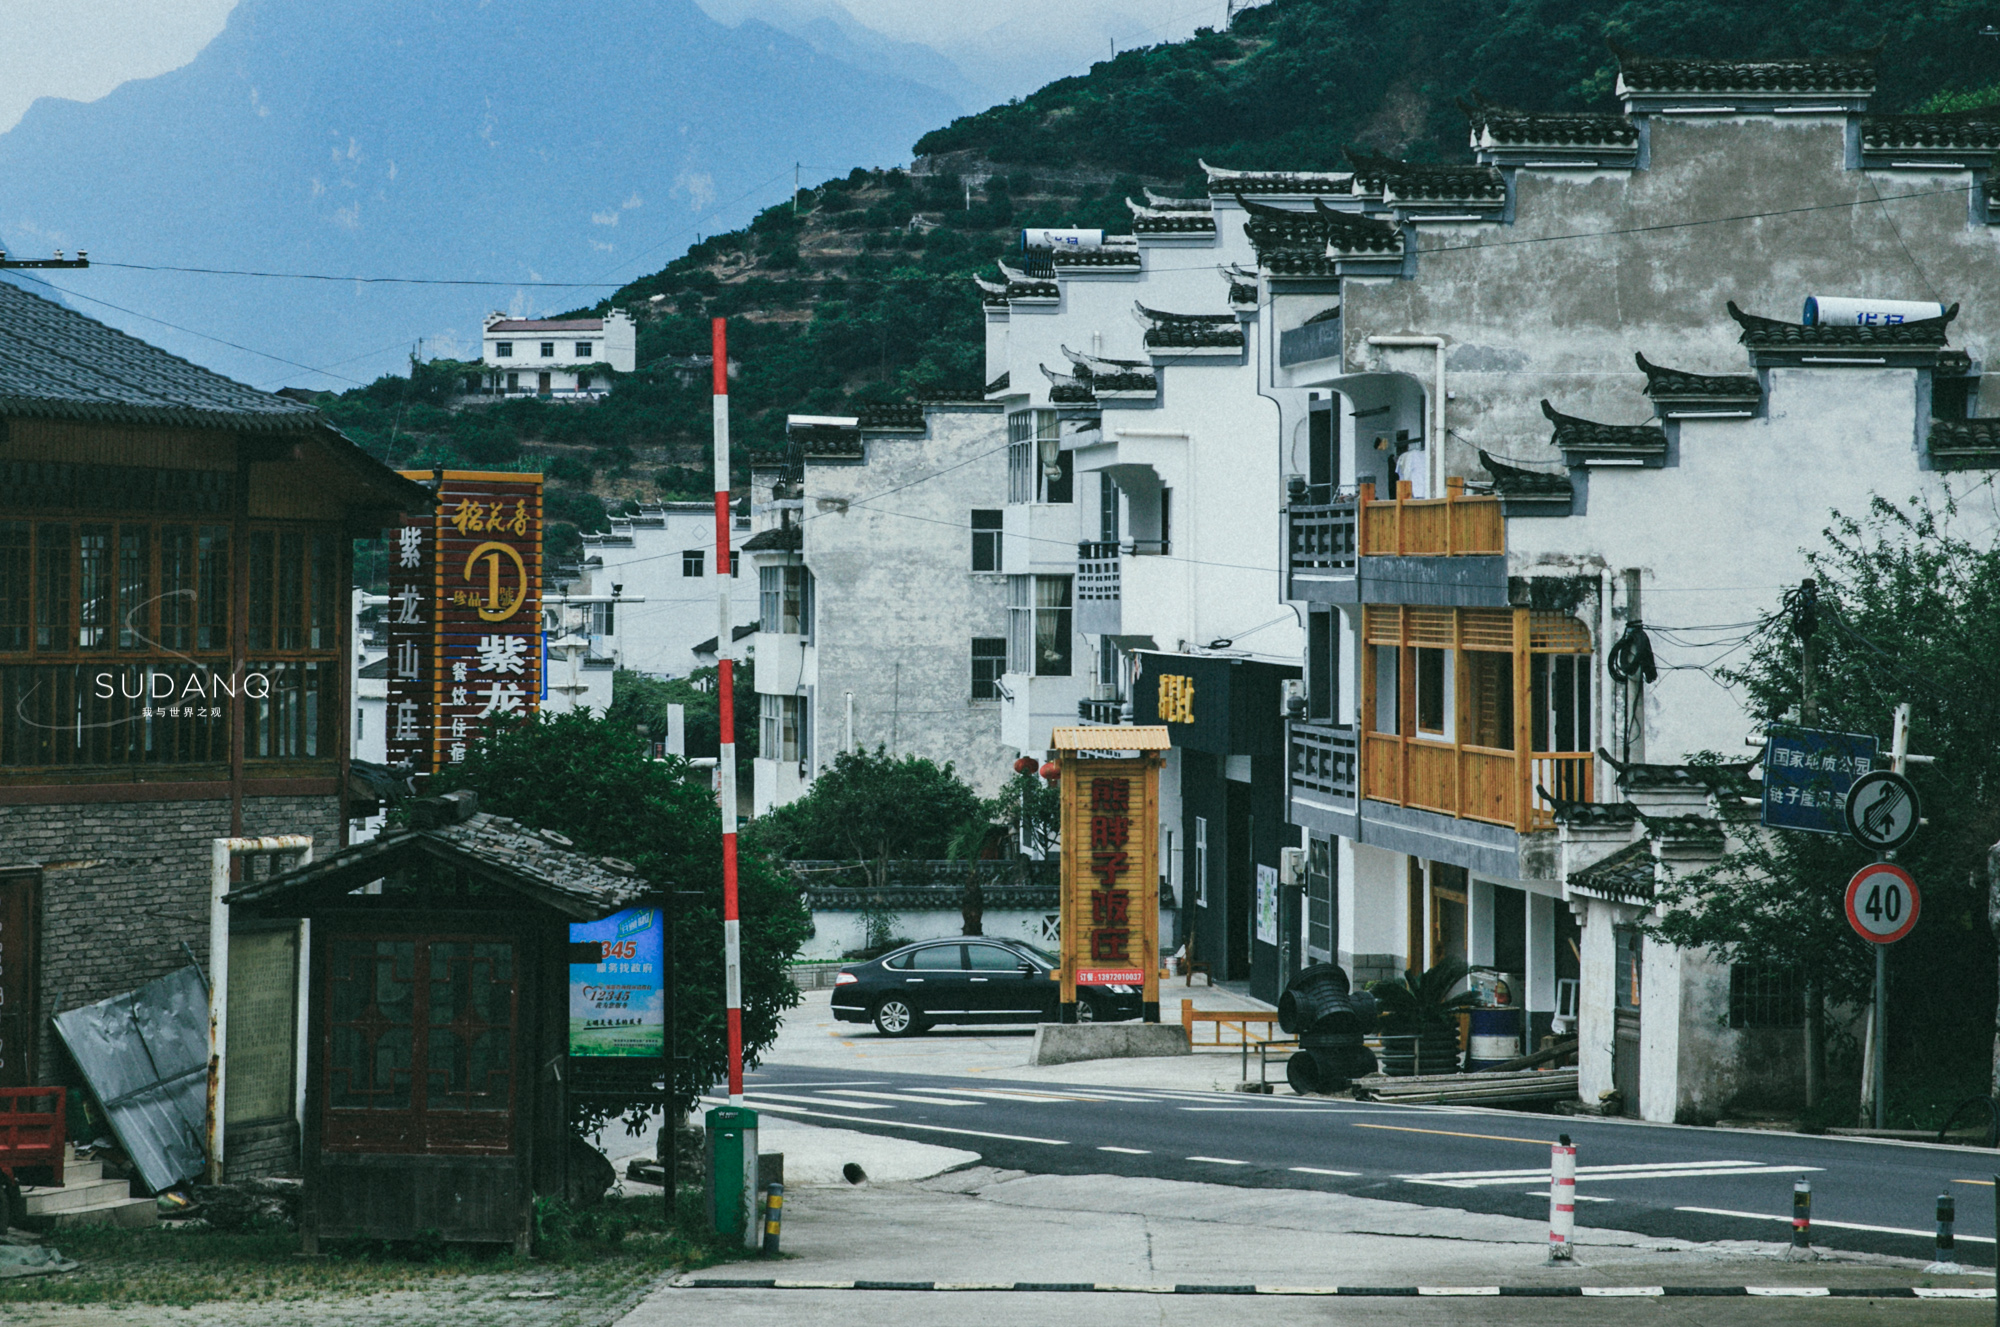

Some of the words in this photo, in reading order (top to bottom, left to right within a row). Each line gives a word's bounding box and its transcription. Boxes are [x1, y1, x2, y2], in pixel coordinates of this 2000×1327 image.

[451, 498, 530, 536] 稻花香
[450, 661, 468, 763] 餐饮住宿
[1773, 747, 1871, 776] 国家地质公园
[1091, 777, 1130, 961] 熊胖子饭庄
[1865, 884, 1901, 922] 40
[596, 962, 653, 973] 服务找政府
[1098, 973, 1142, 981] 13972010037
[590, 990, 631, 1001] 12345
